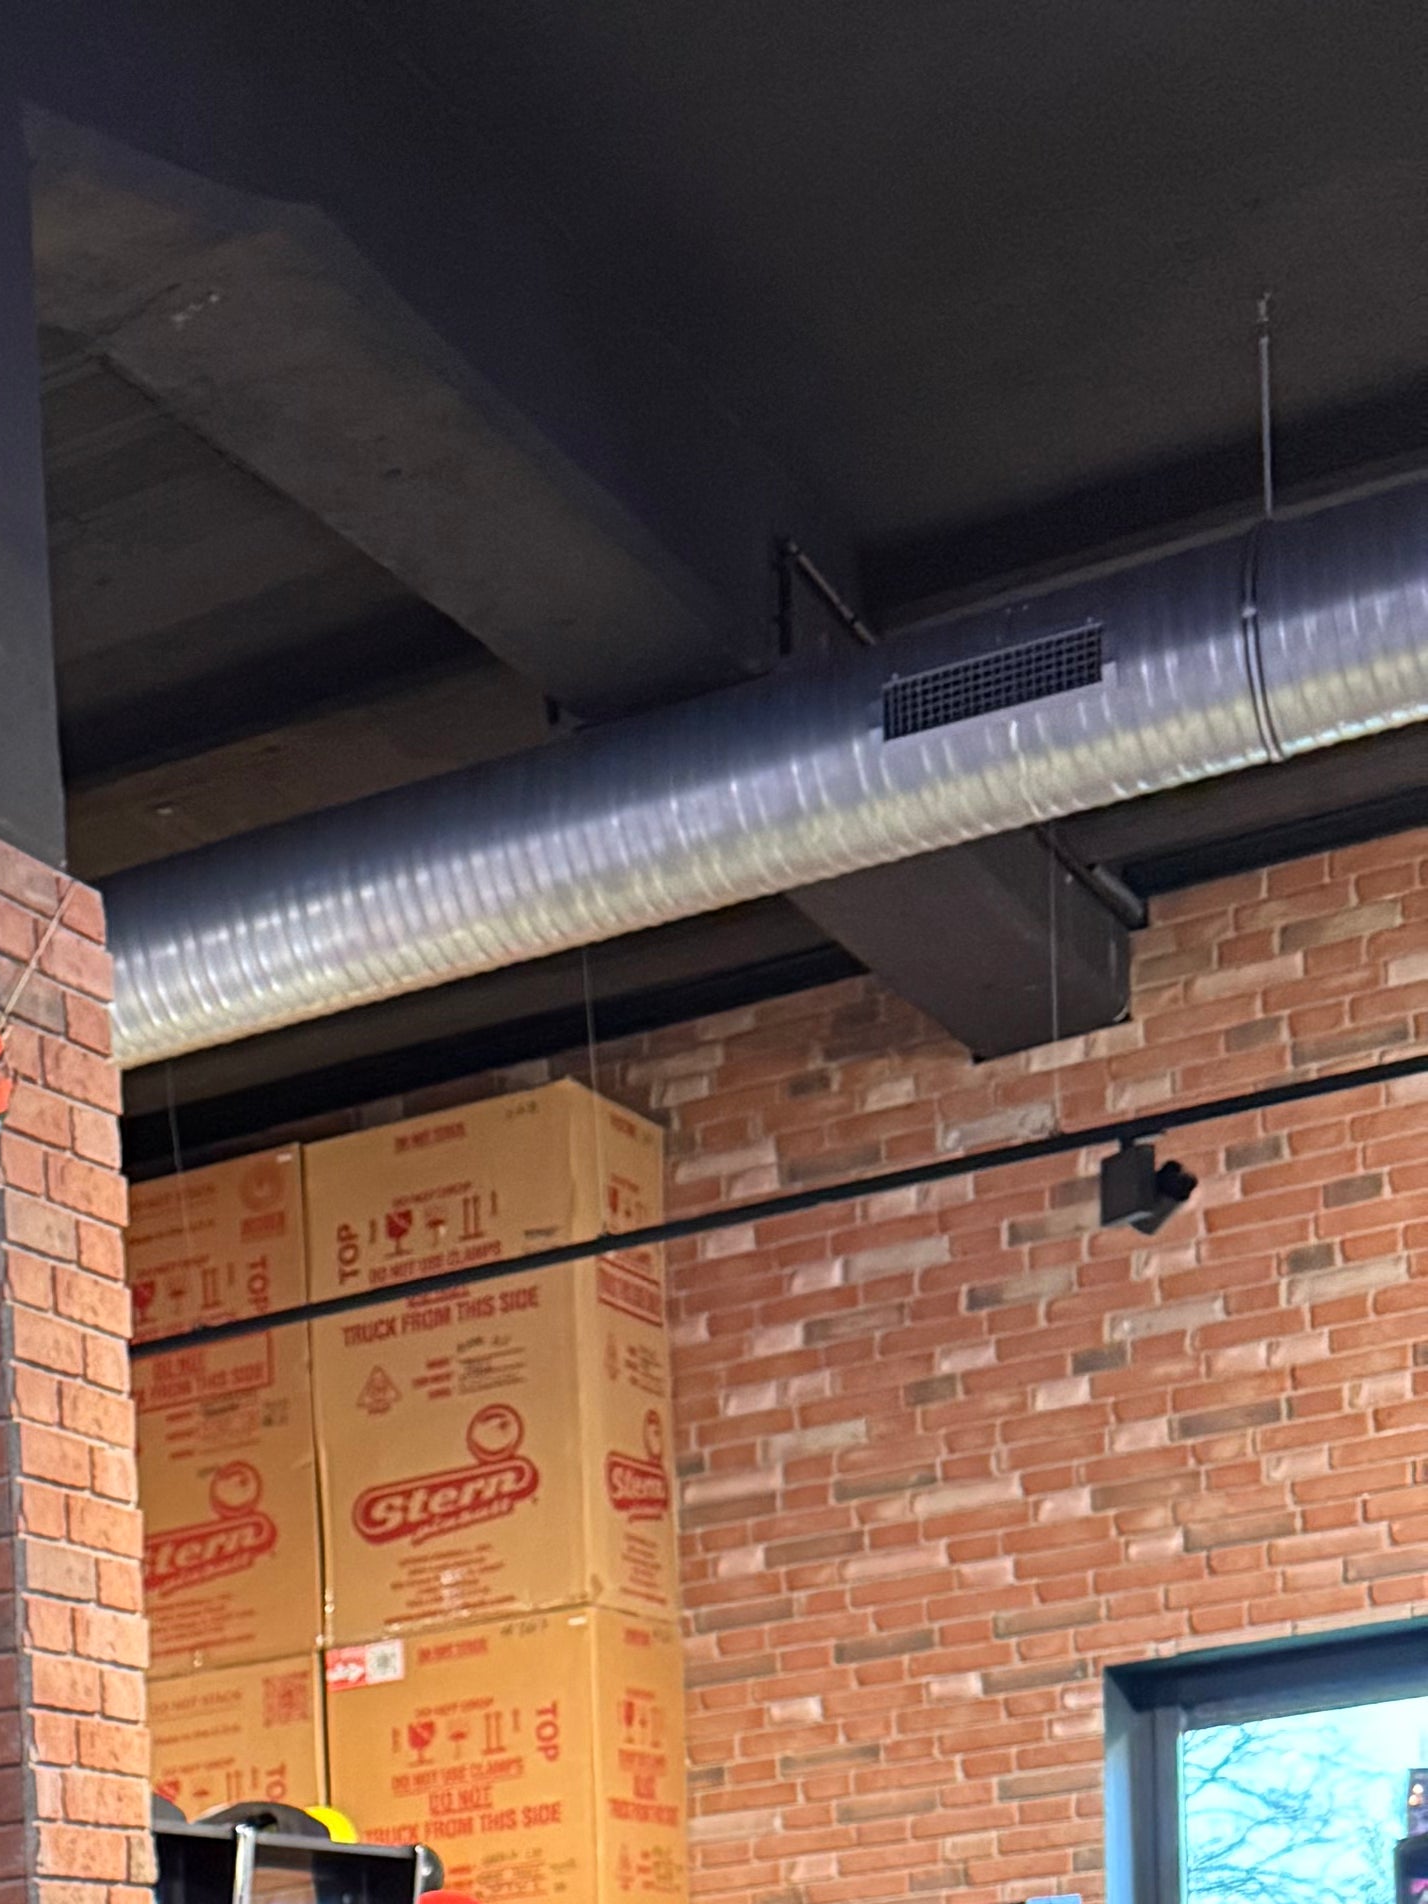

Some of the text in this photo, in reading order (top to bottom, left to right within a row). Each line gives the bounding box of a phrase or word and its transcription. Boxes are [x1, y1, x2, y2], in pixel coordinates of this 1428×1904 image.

[337, 1222, 358, 1285] TOP
[342, 1317, 397, 1347] TRUCK
[401, 1306, 451, 1334] FROM
[457, 1295, 495, 1322] THIS
[499, 1285, 540, 1314] SIDE
[370, 1470, 518, 1530] Stern
[536, 1701, 560, 1763] TOP
[425, 1816, 474, 1839] FROM
[480, 1807, 517, 1832] THIS
[522, 1800, 562, 1828] SIDE
